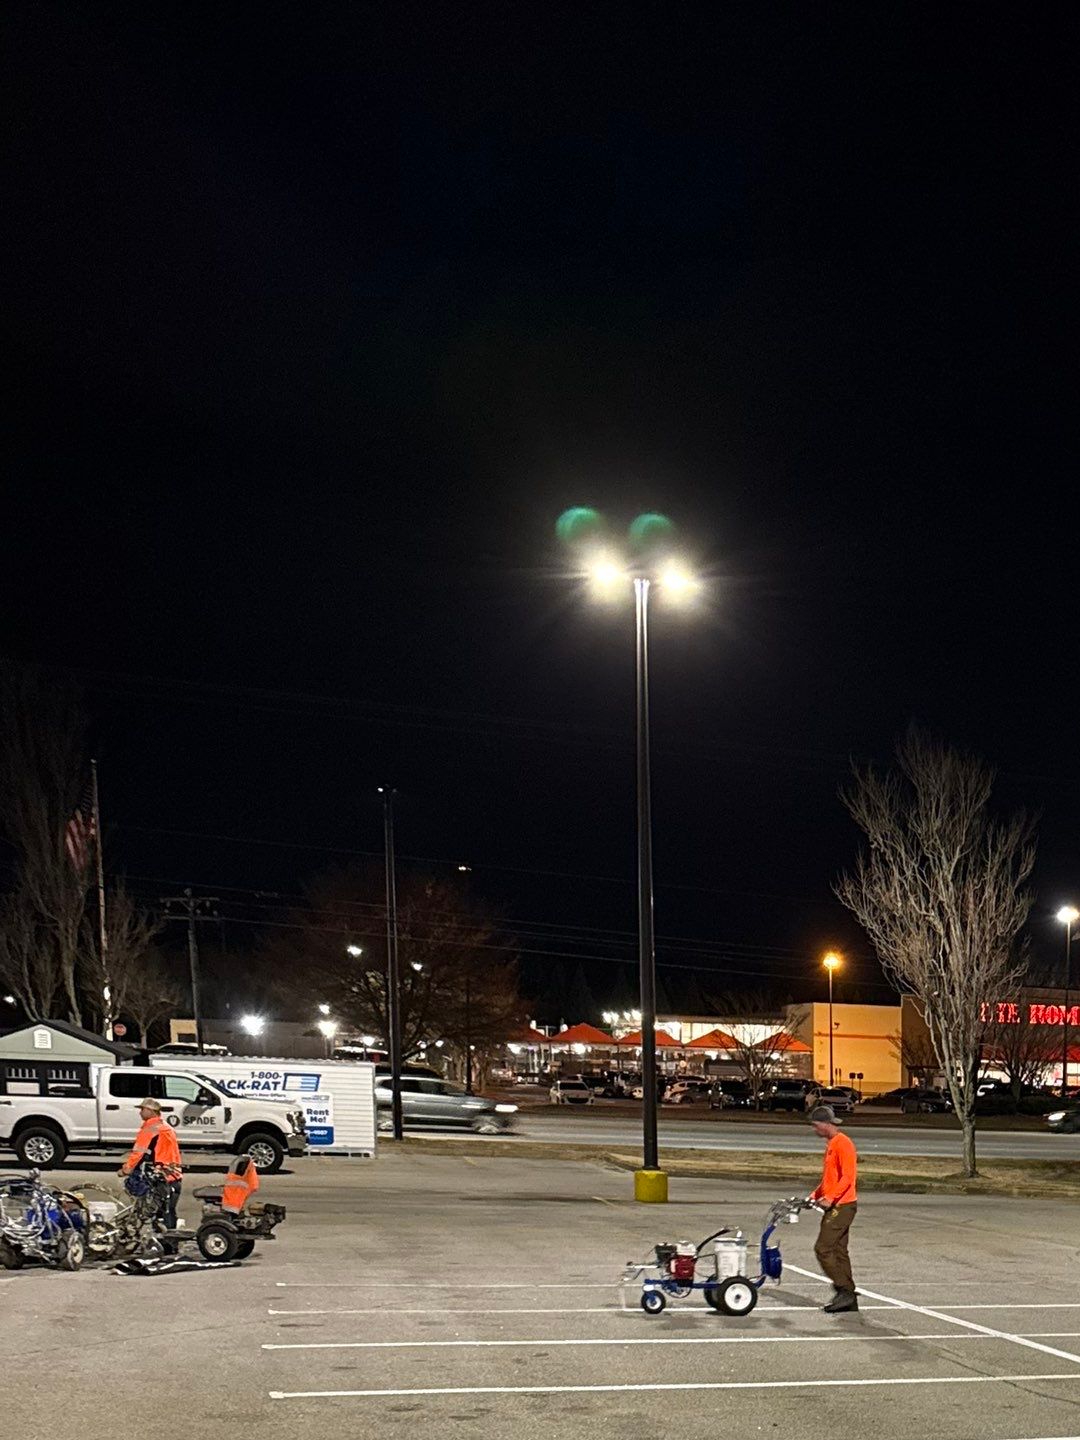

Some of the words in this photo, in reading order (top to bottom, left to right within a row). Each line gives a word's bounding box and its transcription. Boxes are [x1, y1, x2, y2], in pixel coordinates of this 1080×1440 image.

[218, 1079, 281, 1091] ACK-RAT
[306, 1108, 330, 1116] Rent
[182, 1115, 217, 1125] SPADE
